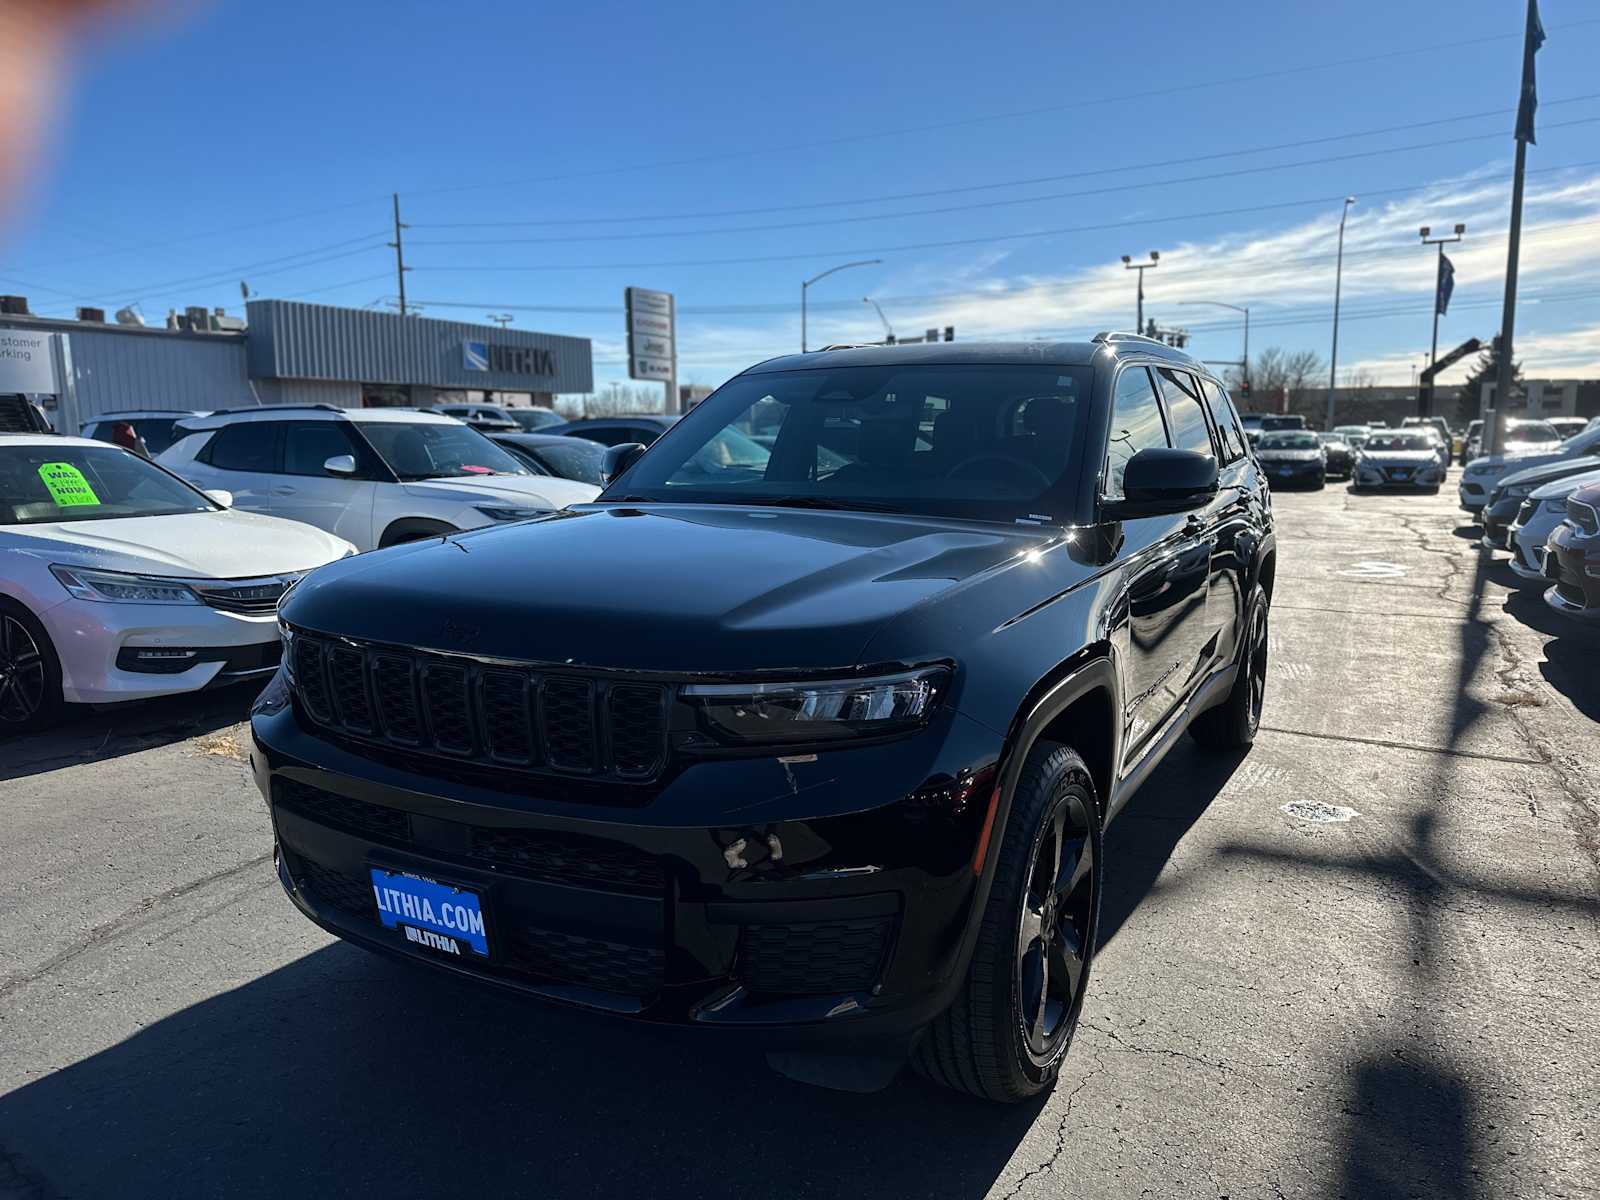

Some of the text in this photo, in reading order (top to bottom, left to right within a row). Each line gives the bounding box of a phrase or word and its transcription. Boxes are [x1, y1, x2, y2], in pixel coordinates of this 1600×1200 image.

[0, 349, 32, 362] rking
[488, 343, 556, 377] LITHIA
[373, 884, 486, 937] LITHIA.COM
[416, 928, 461, 955] LITHIA
